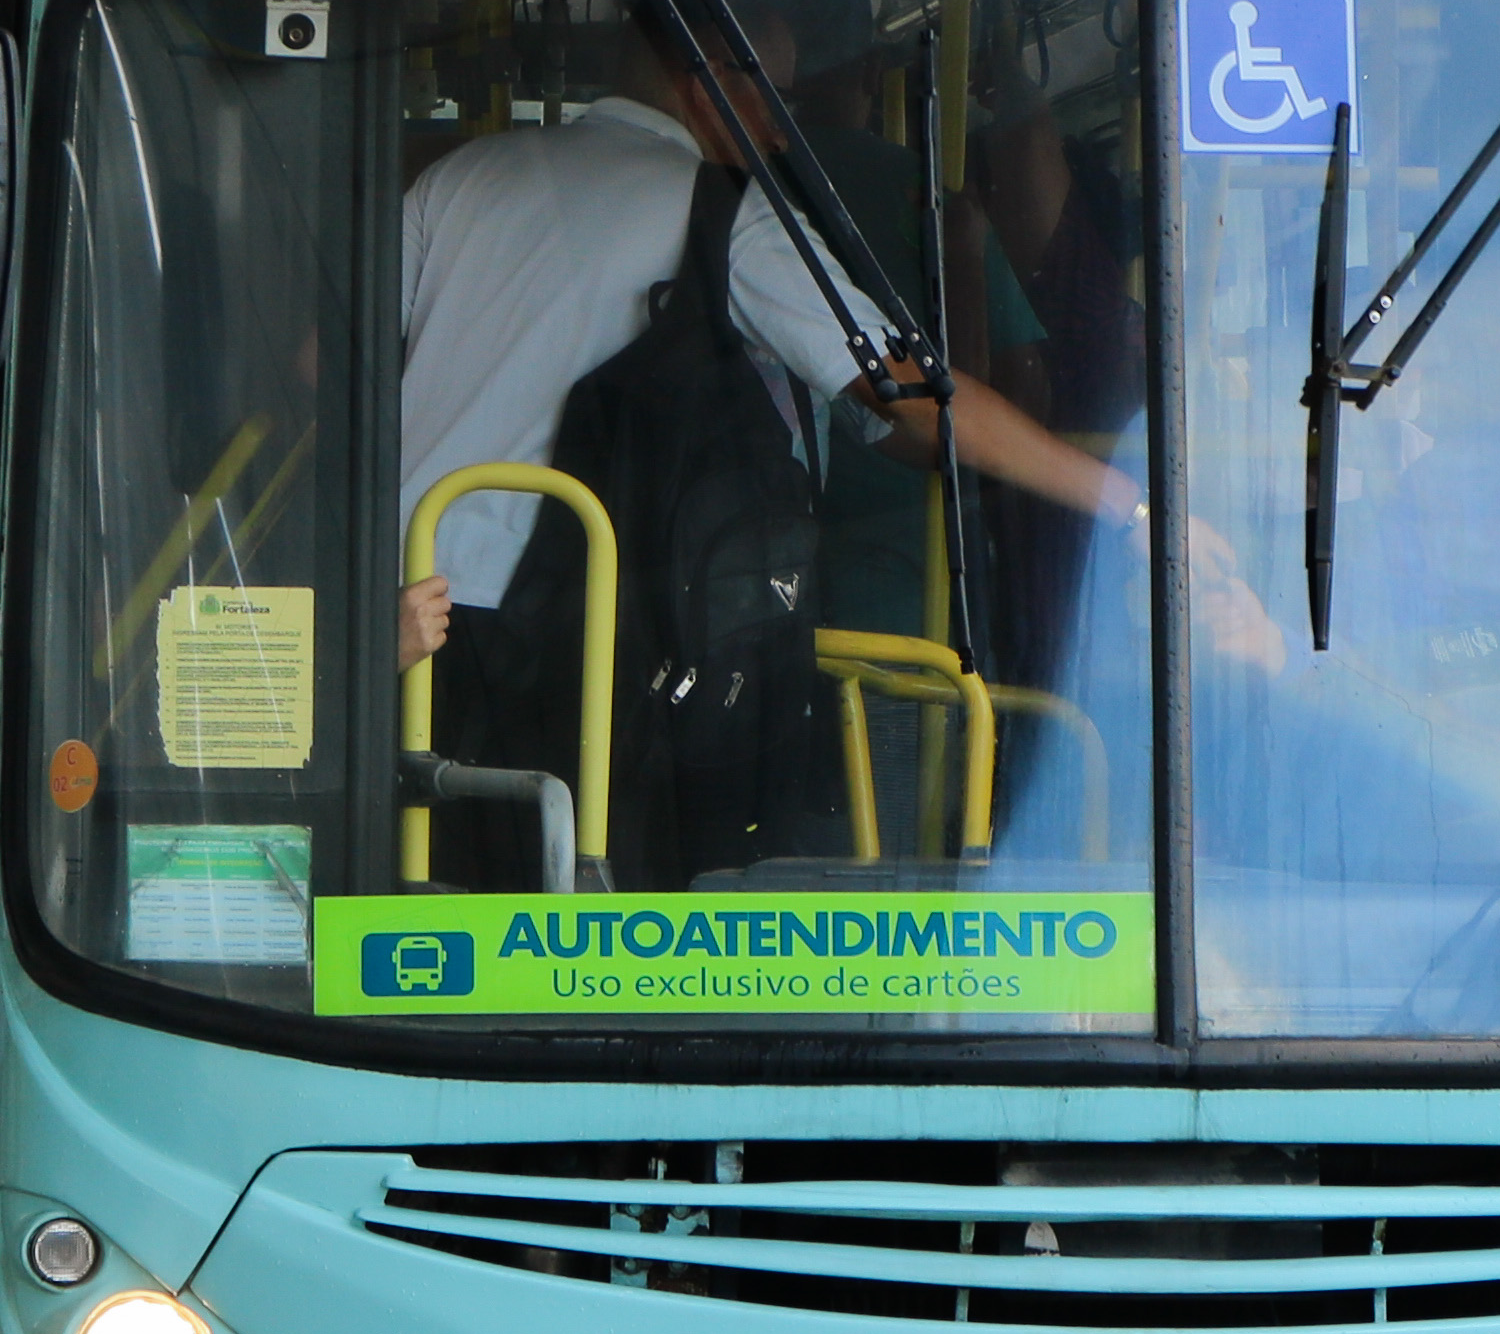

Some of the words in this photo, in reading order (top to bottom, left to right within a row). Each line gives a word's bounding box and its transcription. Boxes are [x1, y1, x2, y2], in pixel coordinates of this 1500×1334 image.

[222, 604, 271, 614] Fortaleza
[497, 909, 1118, 960] AUTOATENDIMENTO
[552, 967, 622, 998] Uso
[634, 965, 811, 998] exclusivo
[822, 964, 870, 998] de
[881, 967, 1021, 998] cartões
